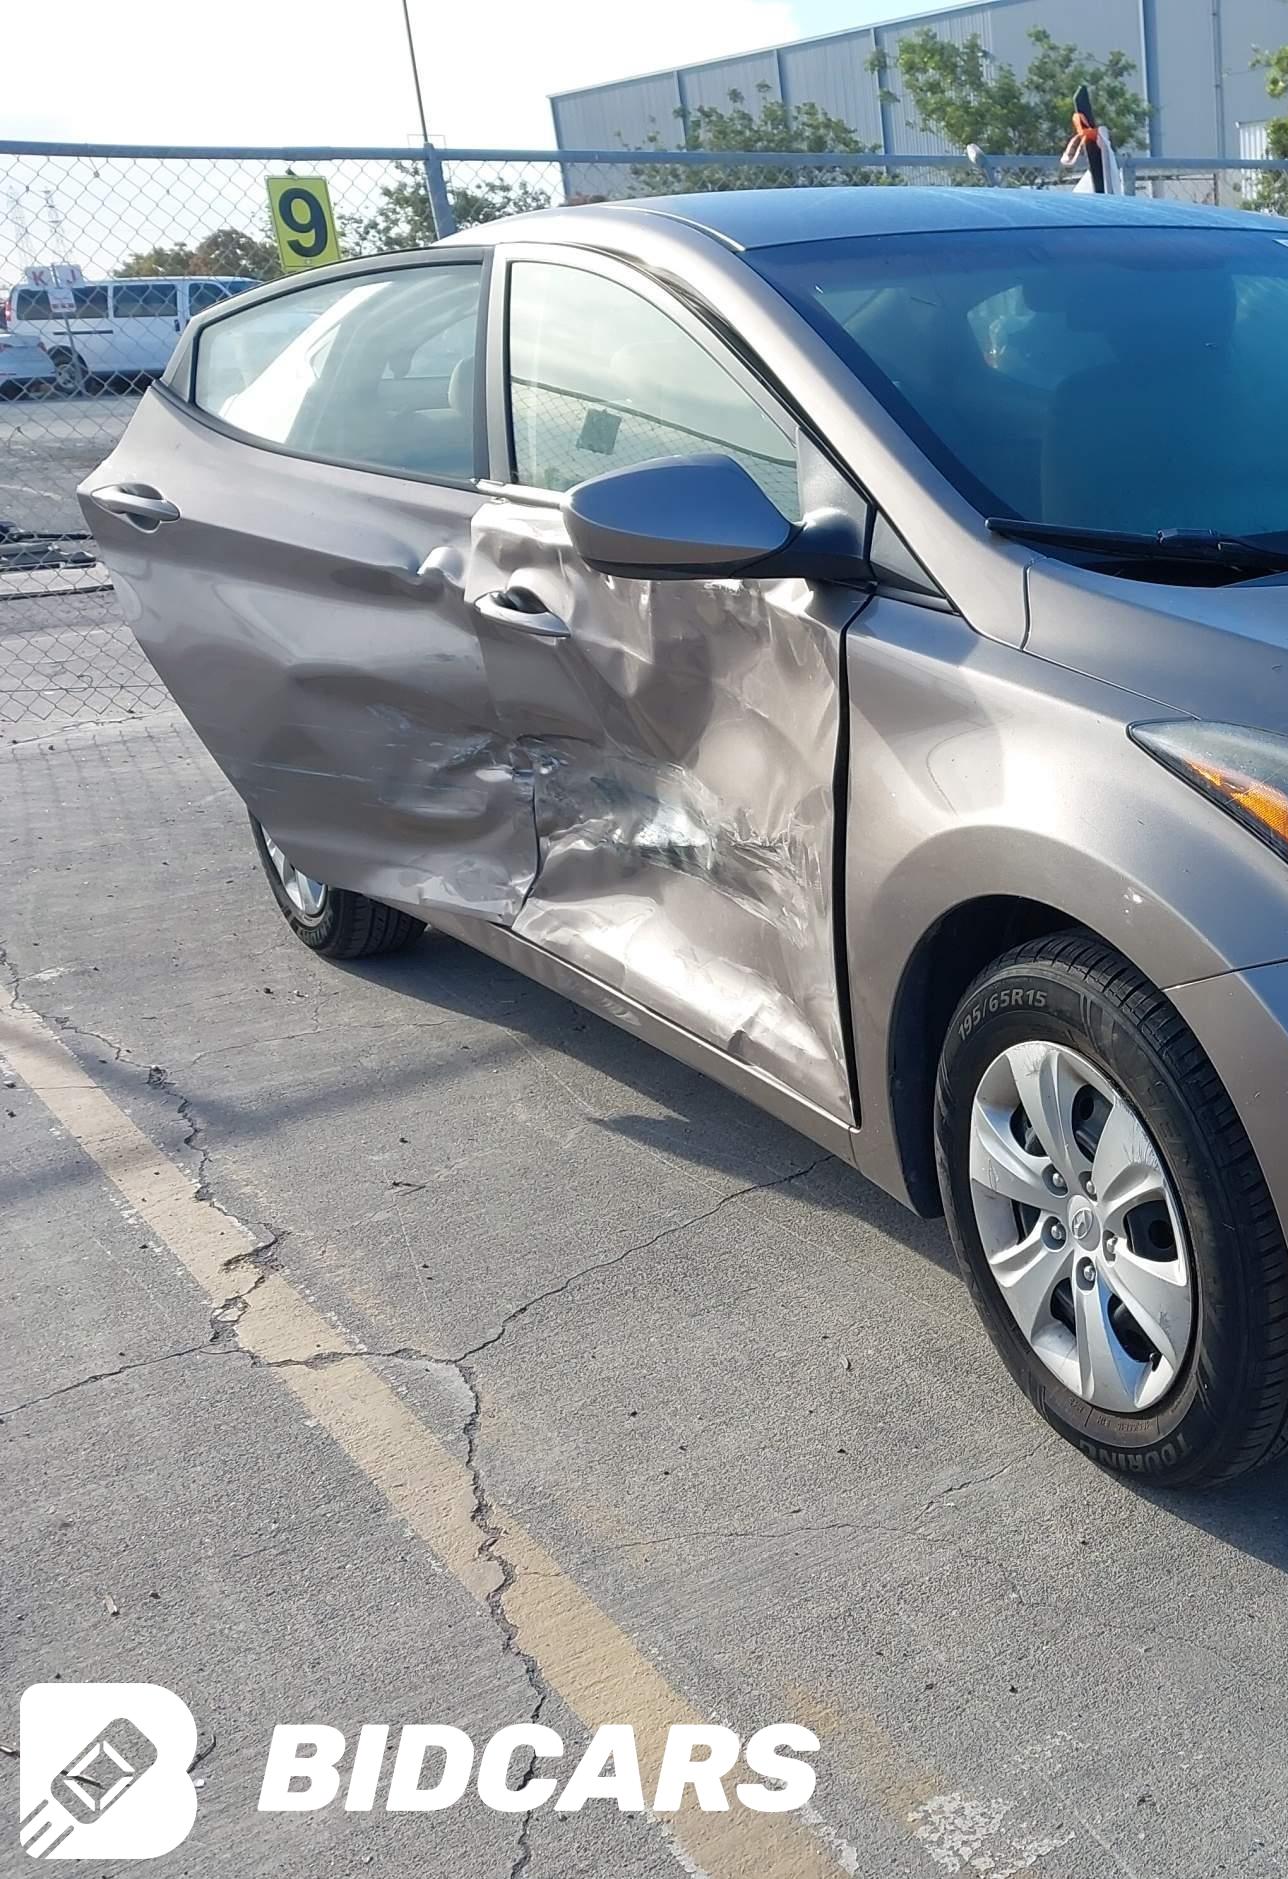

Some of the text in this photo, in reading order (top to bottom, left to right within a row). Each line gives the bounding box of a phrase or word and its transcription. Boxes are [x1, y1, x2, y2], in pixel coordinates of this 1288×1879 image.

[278, 188, 328, 258] 9
[31, 270, 48, 287] K
[958, 988, 1048, 1041] 195/65R15
